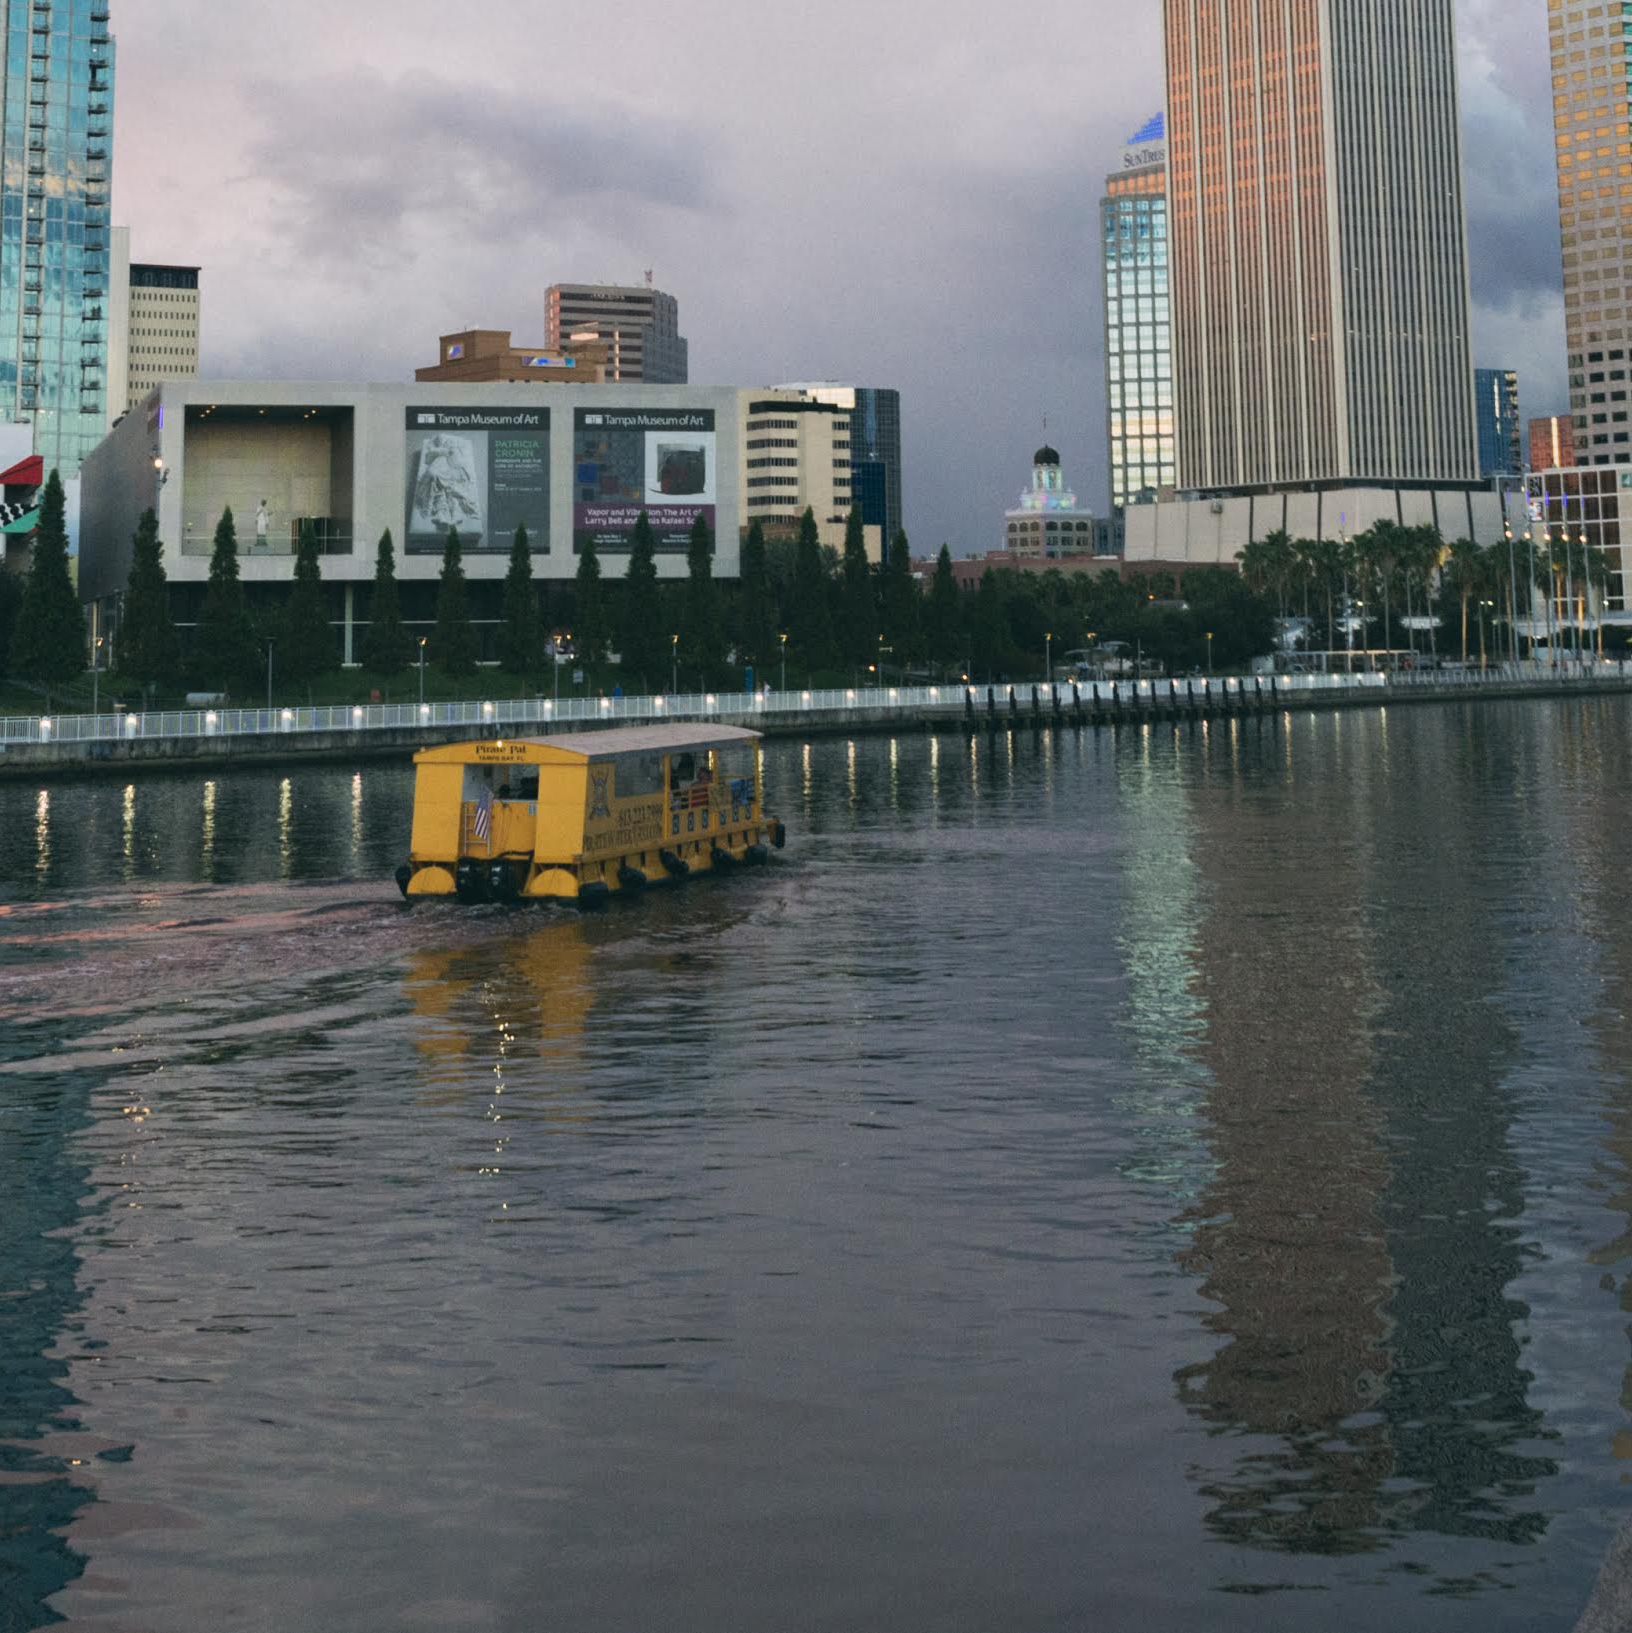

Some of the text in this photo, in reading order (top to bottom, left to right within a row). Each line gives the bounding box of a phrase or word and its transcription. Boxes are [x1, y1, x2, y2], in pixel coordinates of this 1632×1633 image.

[1124, 148, 1166, 168] SUNTRUS
[437, 413, 539, 426] Tampa Museum of Art
[605, 415, 704, 427] Tampa Museum of Art
[494, 440, 540, 448] PATRICIA
[494, 449, 534, 458] CRONIN
[587, 508, 609, 517] Vapor
[610, 508, 625, 516] and
[663, 508, 677, 516] The
[679, 508, 691, 516] Art
[585, 517, 607, 526] Larry
[475, 745, 506, 754] Pirate
